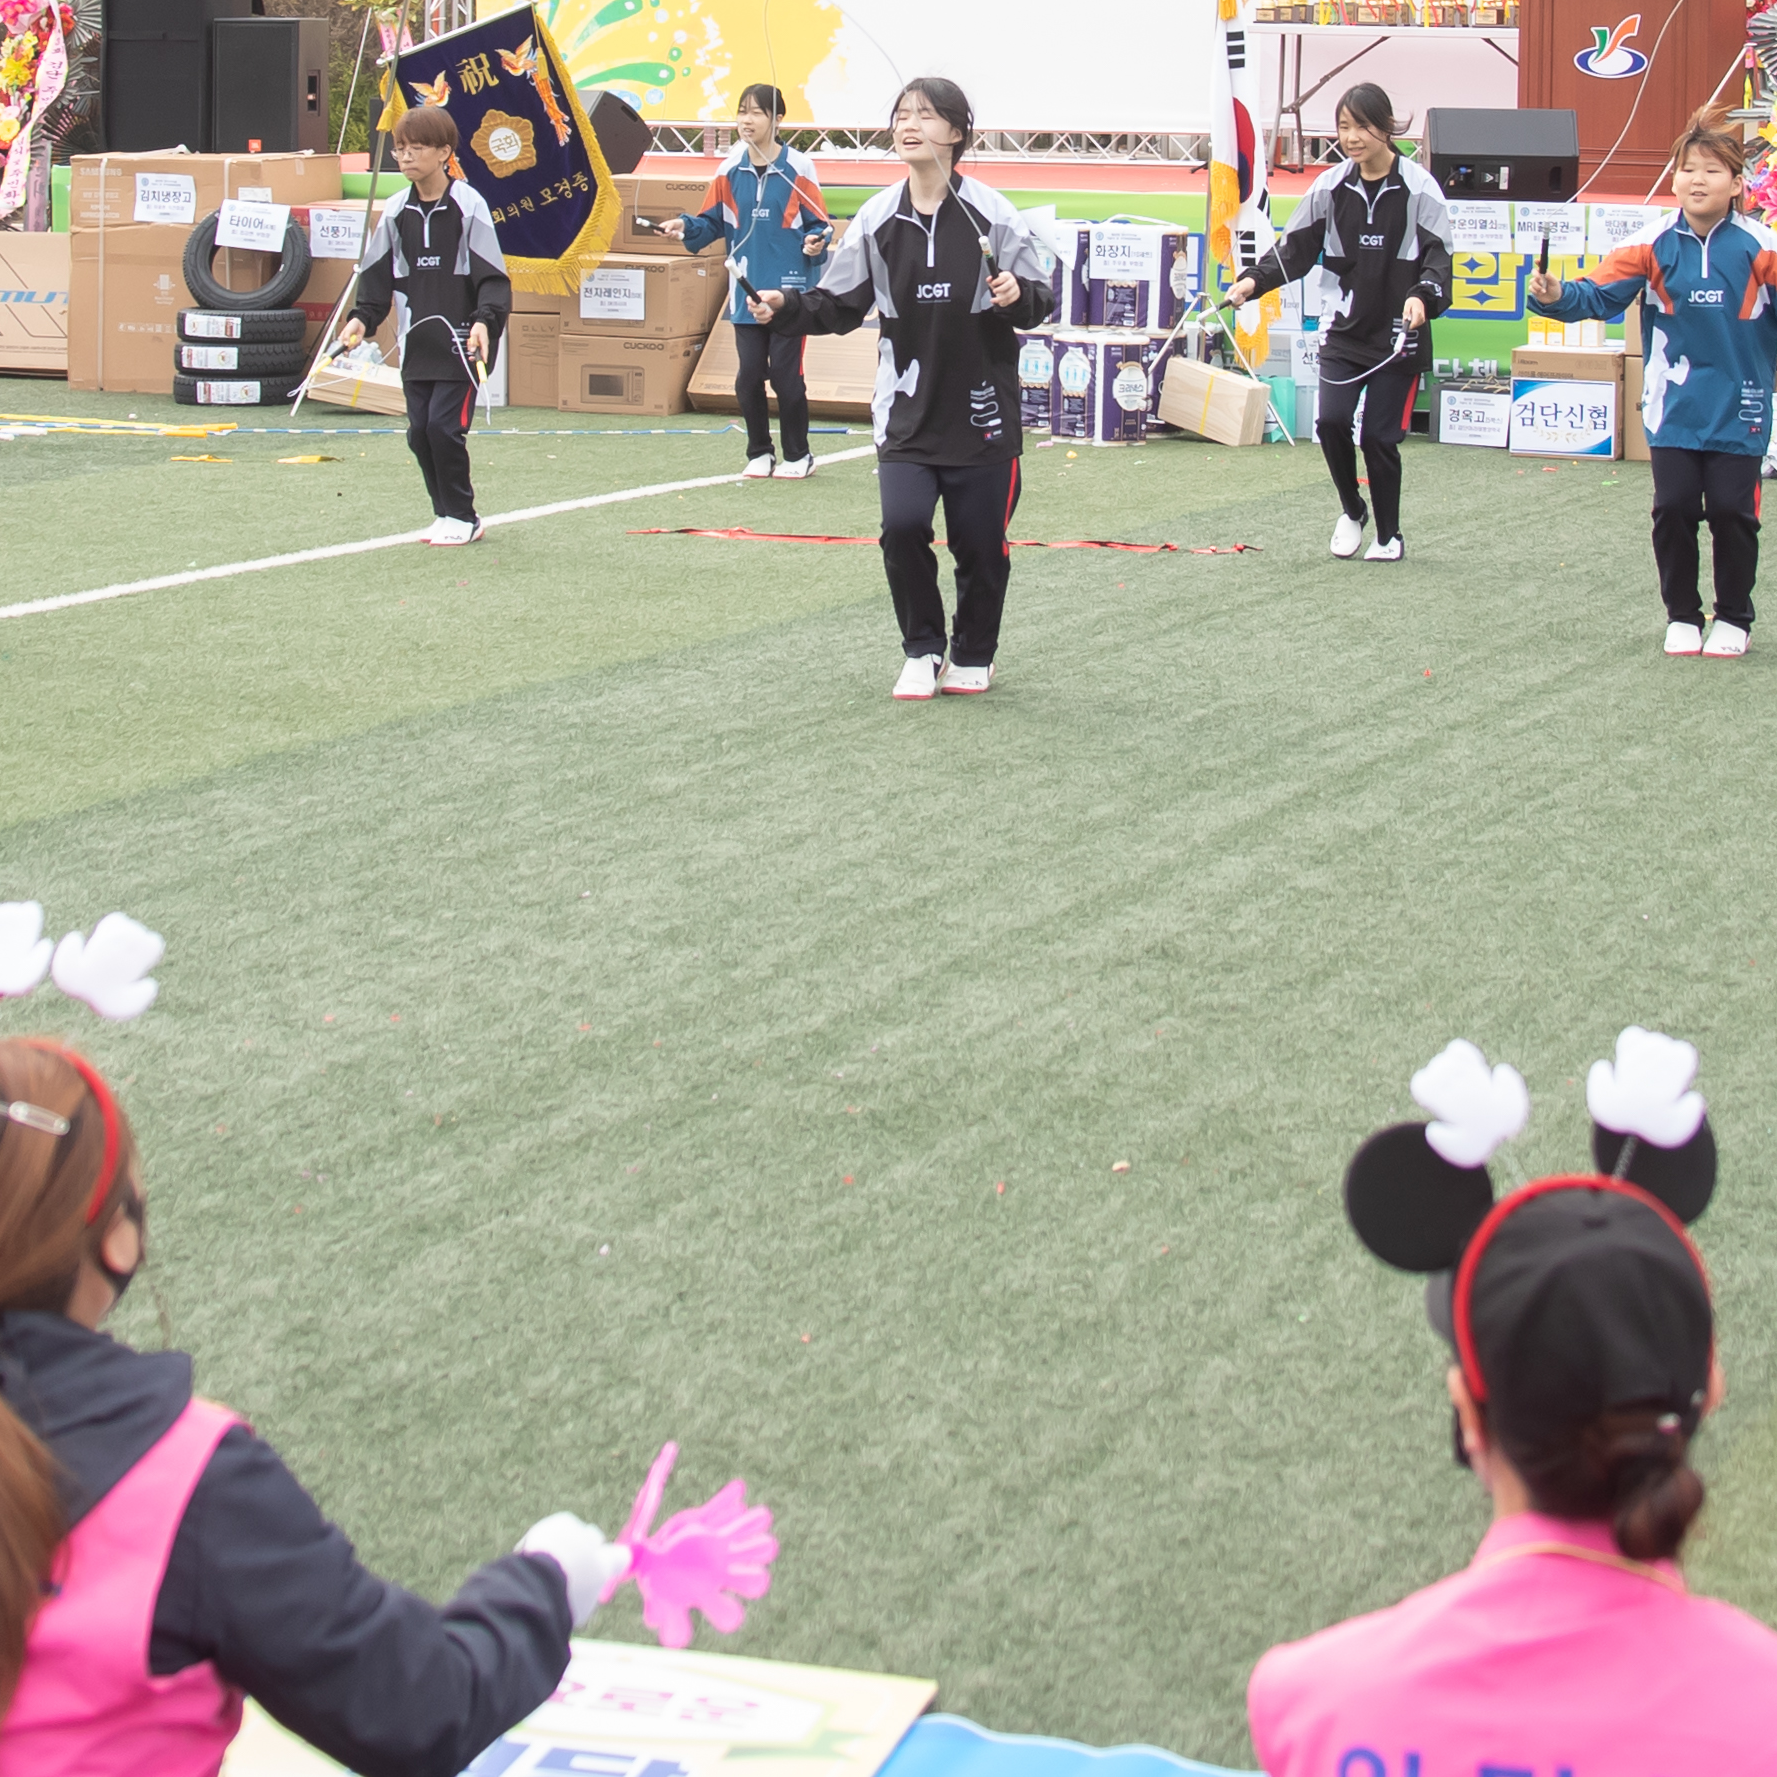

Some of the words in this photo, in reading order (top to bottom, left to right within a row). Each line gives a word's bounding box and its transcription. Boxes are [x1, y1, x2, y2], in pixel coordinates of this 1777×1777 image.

[455, 53, 499, 95] 祝
[491, 132, 520, 154] 국회
[665, 183, 706, 191] CUCKOO
[140, 190, 192, 204] 김치냉장고
[229, 215, 264, 230] 타이어
[319, 225, 351, 239] 선풍기
[1095, 244, 1131, 258] 화장지
[416, 256, 441, 267] JCGT
[583, 287, 631, 299] 전자레인지
[916, 283, 951, 299] JCGT
[1688, 290, 1724, 303] JCGT
[623, 341, 665, 351] CUCKOO
[1448, 408, 1486, 423] 경옥고
[1515, 401, 1608, 431] 검단신협
